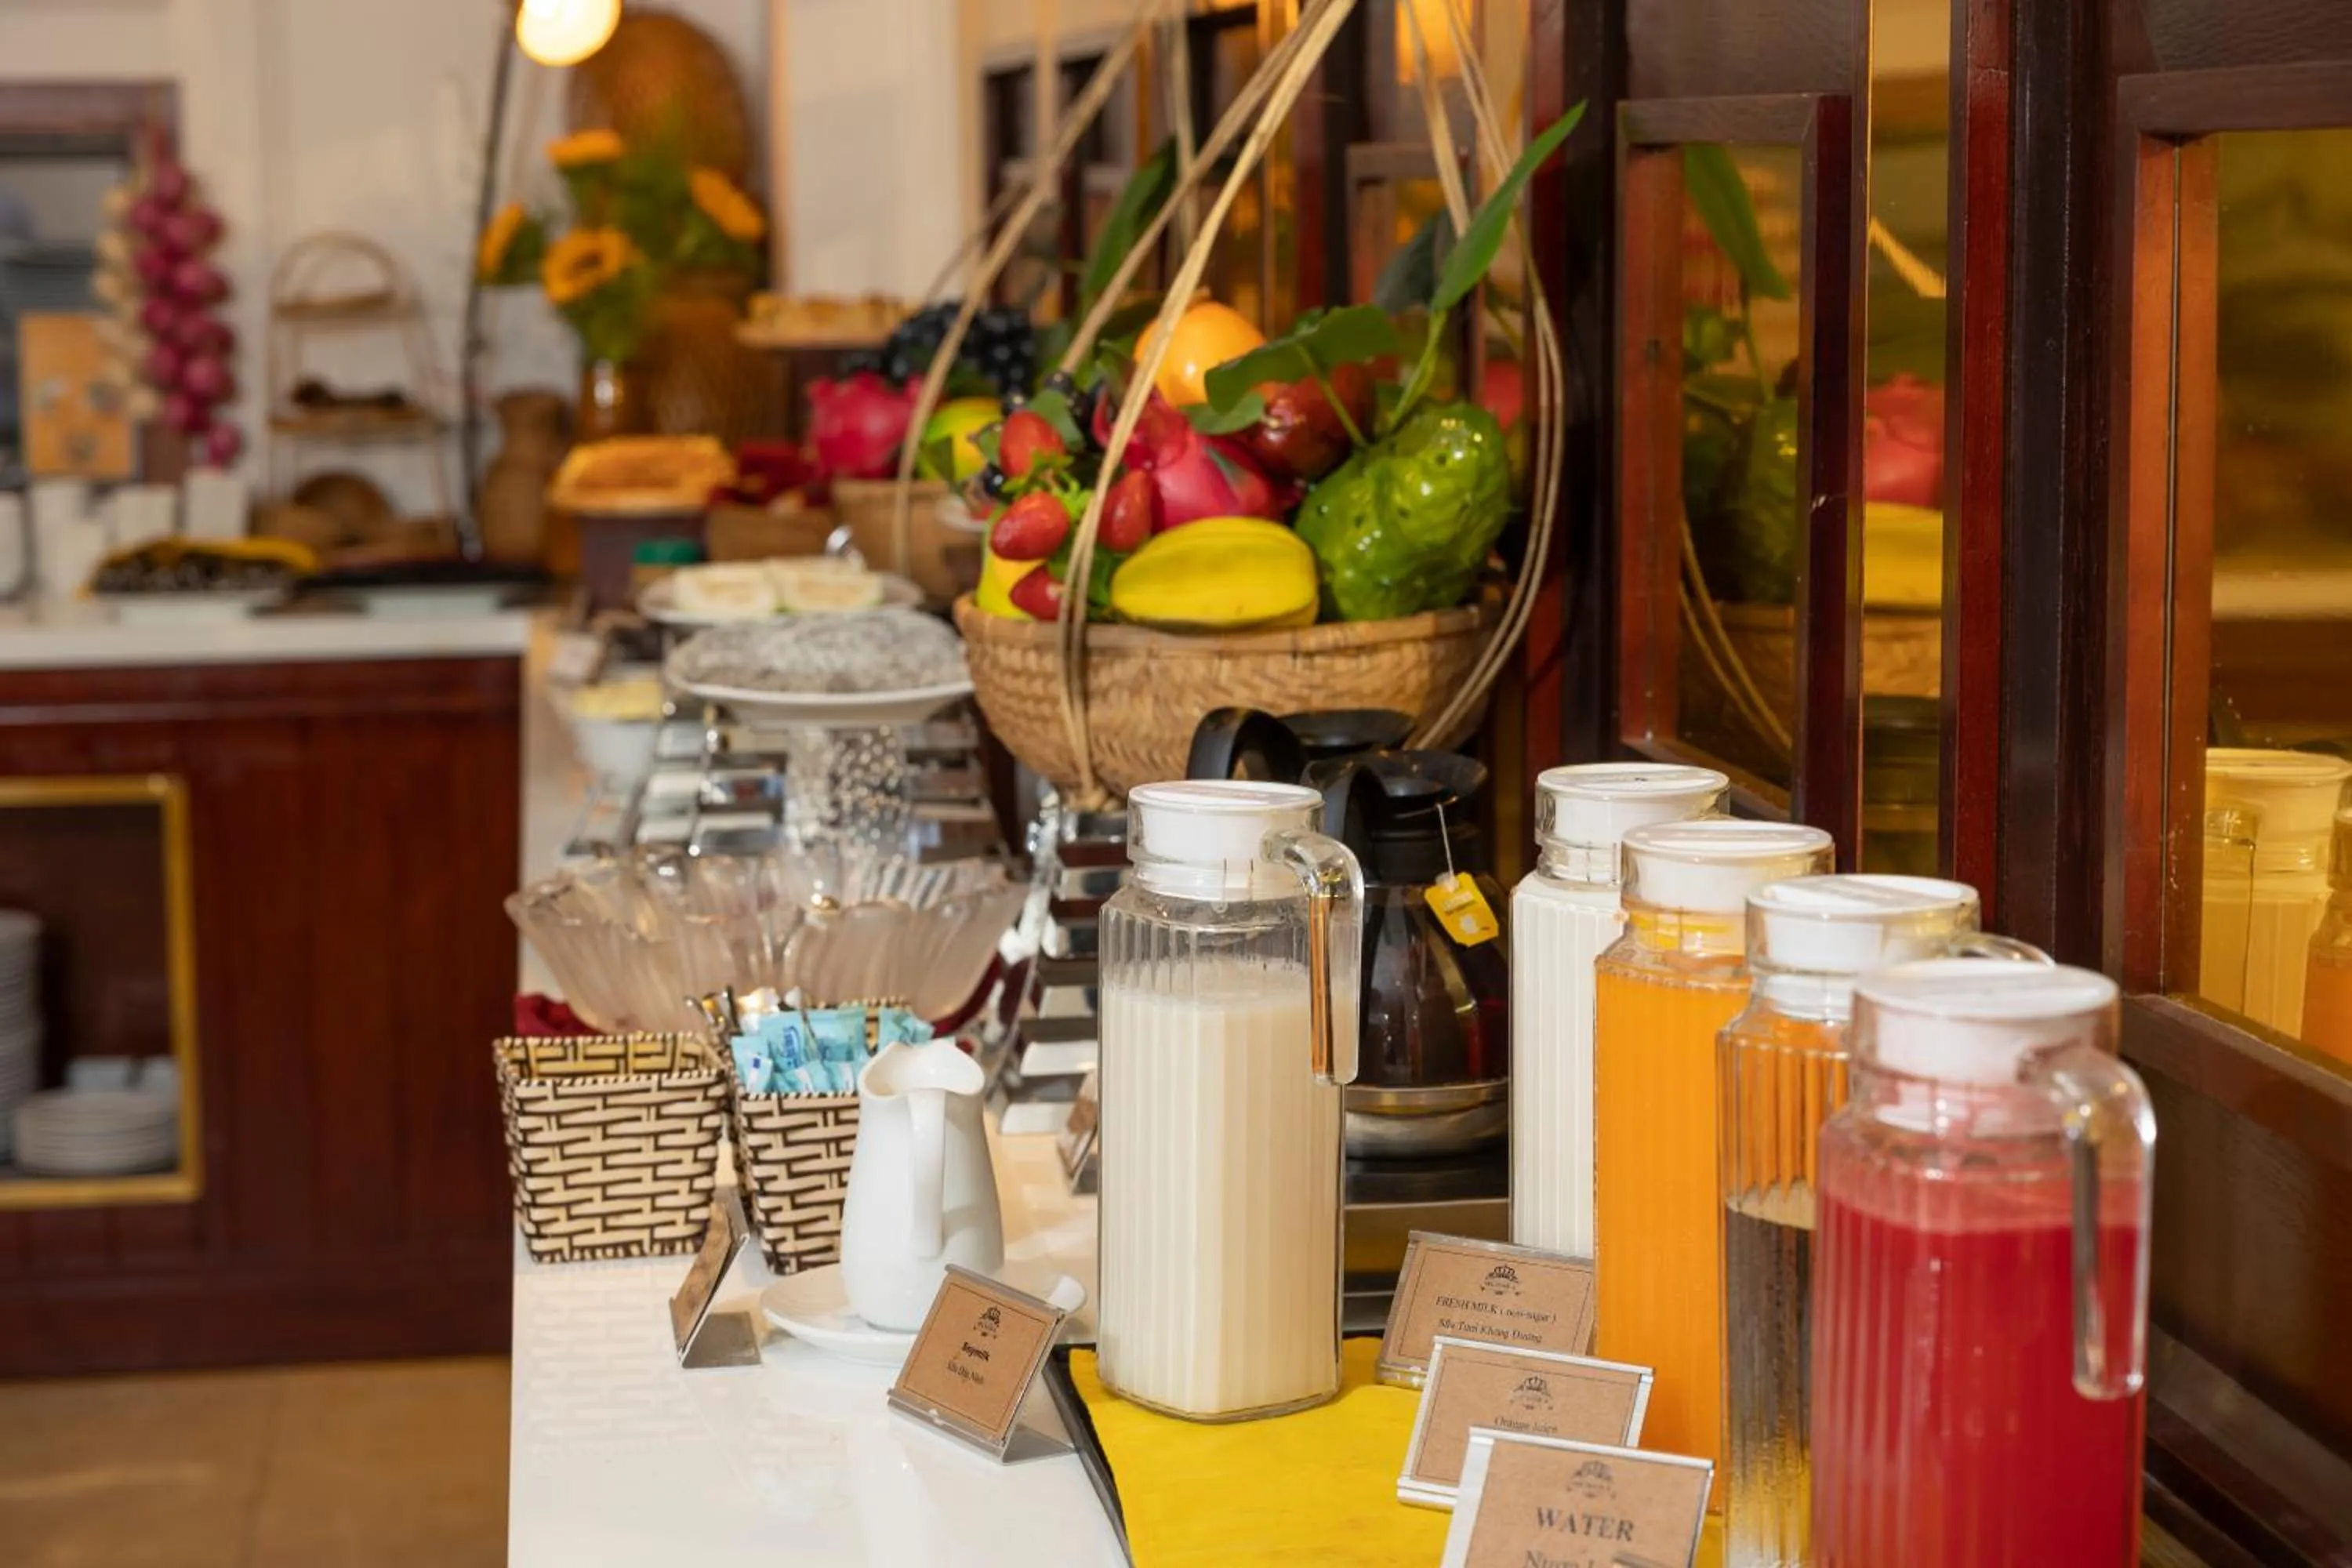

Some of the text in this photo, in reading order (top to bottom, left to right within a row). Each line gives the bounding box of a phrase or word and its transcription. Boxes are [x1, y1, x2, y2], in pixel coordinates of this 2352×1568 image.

[1436, 1296, 1470, 1310] FRESH
[1471, 1301, 1498, 1315] MILK
[1537, 1506, 1635, 1542] WATER
